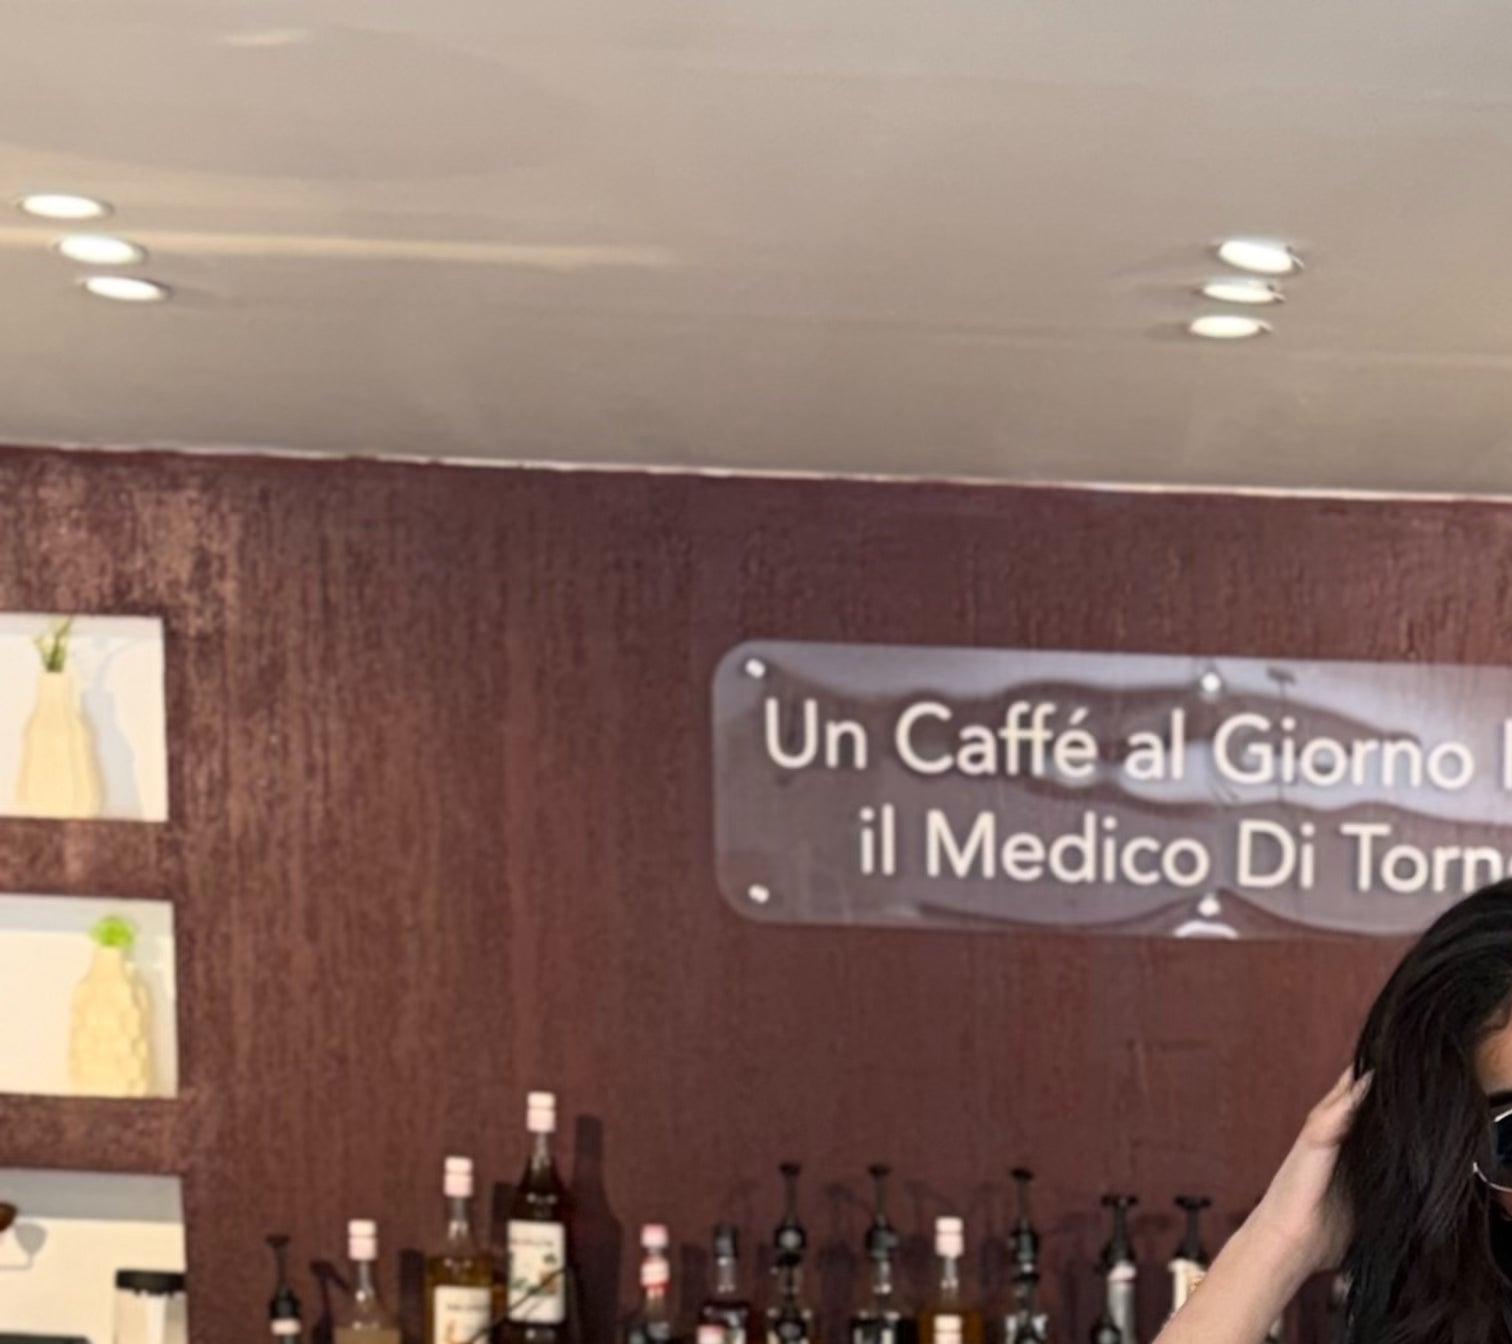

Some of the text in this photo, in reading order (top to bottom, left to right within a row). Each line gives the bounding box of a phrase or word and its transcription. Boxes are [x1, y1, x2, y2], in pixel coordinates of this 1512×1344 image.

[764, 697, 868, 770] Un
[895, 701, 1099, 779] Caffé
[1124, 707, 1186, 782] al
[1212, 713, 1475, 790] Giorno
[859, 803, 896, 876] il
[926, 808, 1211, 888] Medico
[1237, 818, 1316, 890] Di
